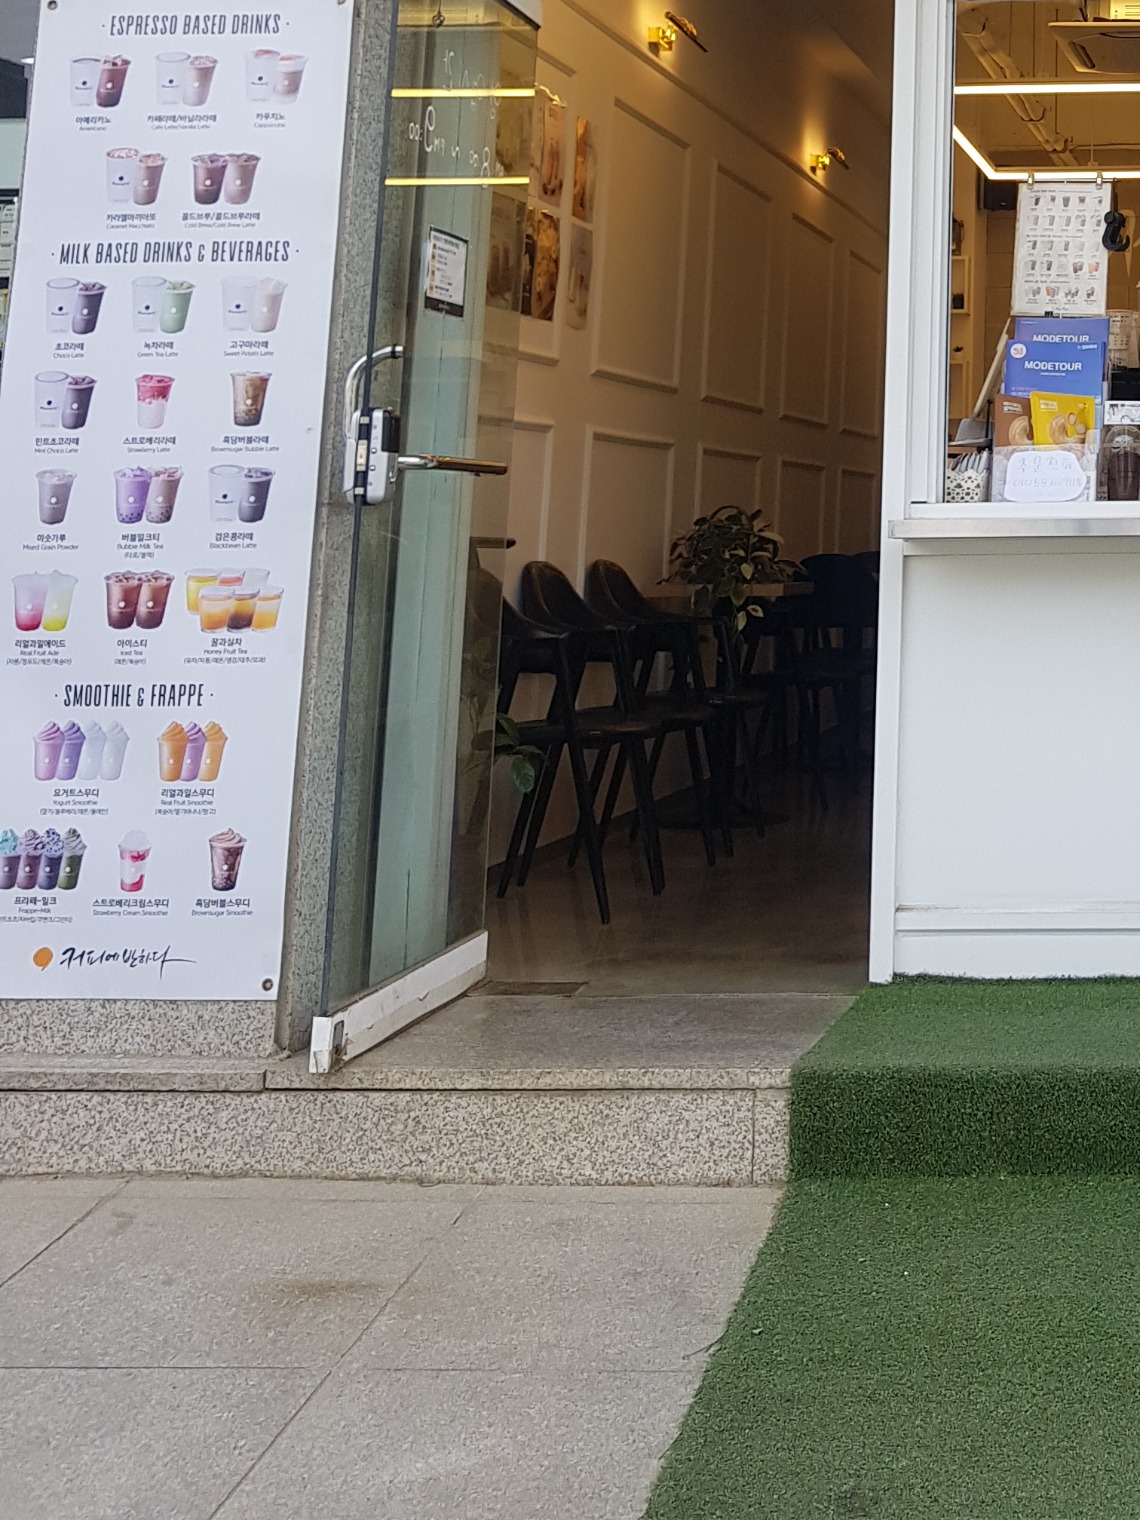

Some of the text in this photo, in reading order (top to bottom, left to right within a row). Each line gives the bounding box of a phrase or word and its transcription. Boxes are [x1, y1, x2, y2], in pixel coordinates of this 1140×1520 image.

[110, 13, 282, 36] ESPRESSO BASED DRINKS
[60, 243, 91, 265] MILK
[95, 242, 138, 264] BASED
[143, 241, 192, 263] DRINKS
[211, 241, 290, 262] BEVERAGES
[1032, 334, 1090, 343] MODETOUR
[55, 342, 84, 351] 초코라떼
[143, 341, 174, 350] 녹차라떼
[230, 340, 269, 349] 고구마라떼
[1024, 361, 1082, 371] MODETOUR
[215, 532, 254, 541] 검은콩라떼
[117, 639, 148, 648] 아이스티
[64, 684, 132, 707] SMOOTHIE
[151, 683, 205, 707] FRAPPE
[53, 788, 99, 798] 요거트스무디
[60, 945, 197, 980] 커피에 반하다
